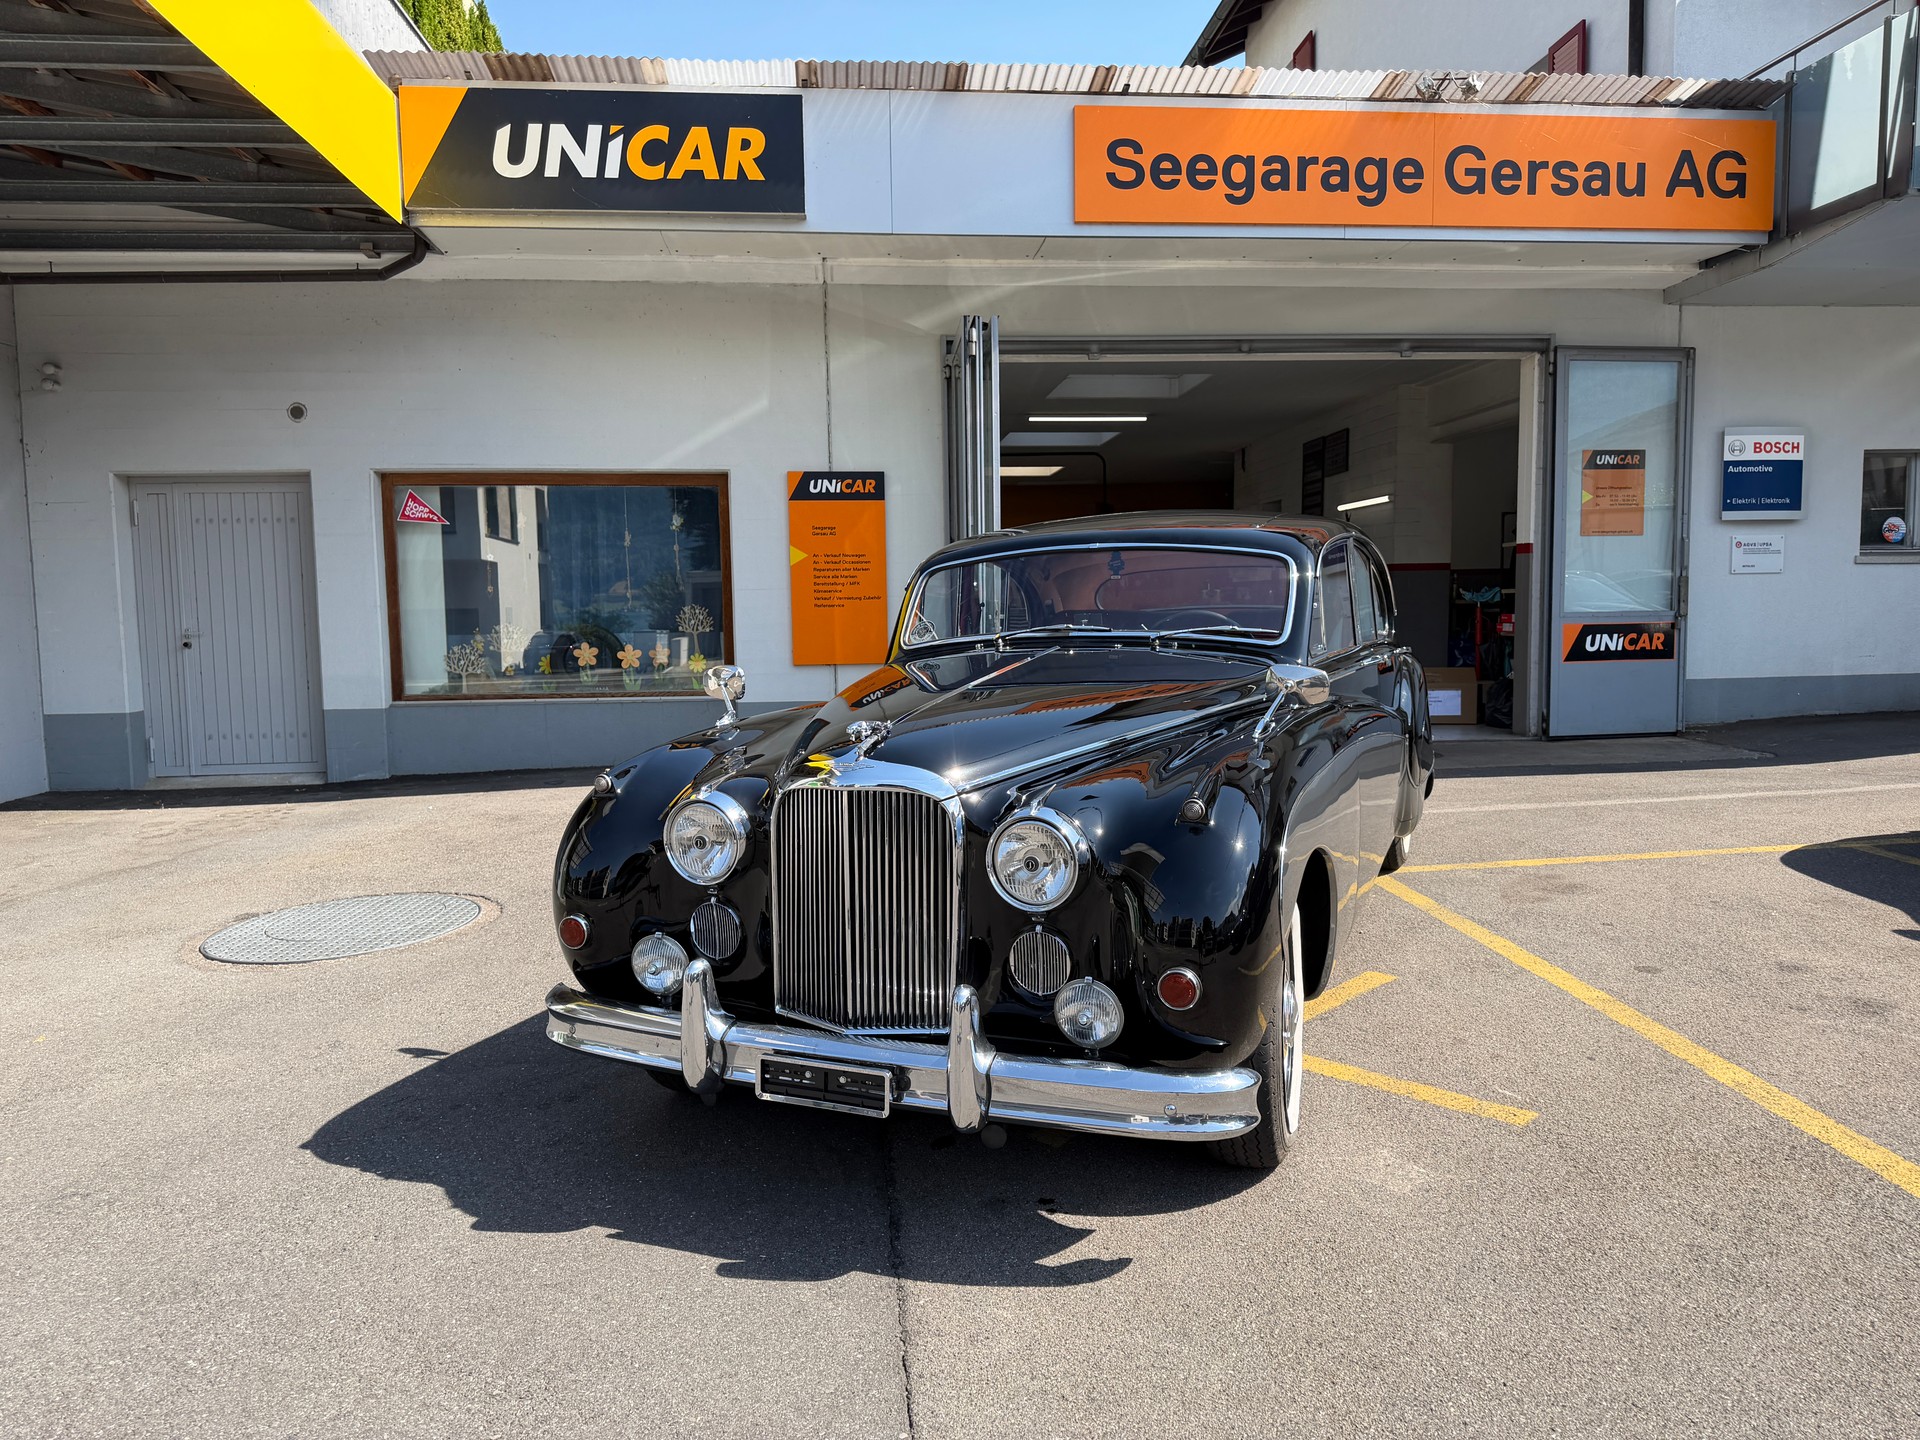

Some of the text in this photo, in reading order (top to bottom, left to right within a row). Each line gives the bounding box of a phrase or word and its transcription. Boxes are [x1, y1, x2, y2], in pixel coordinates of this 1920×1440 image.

[1105, 138, 1749, 207] Seegarage Gersau AG
[1753, 441, 1800, 454] BOSCH
[1727, 464, 1773, 473] Automotive
[407, 498, 430, 513] HOPP
[1732, 497, 1757, 505] Elektrik
[404, 506, 439, 522] SCHWYZ
